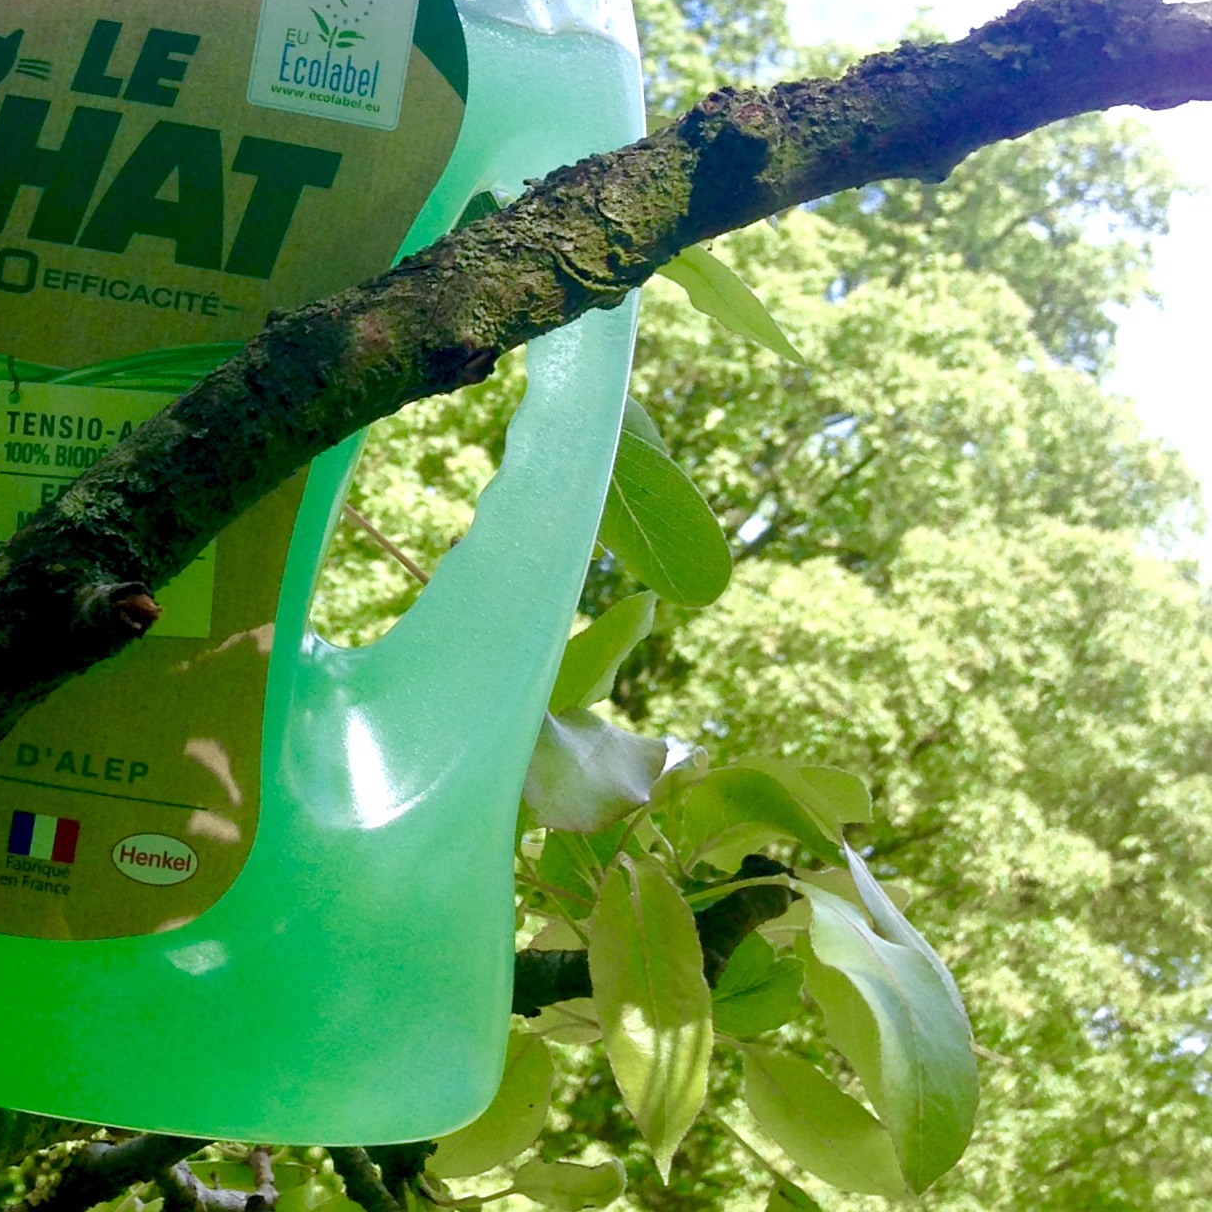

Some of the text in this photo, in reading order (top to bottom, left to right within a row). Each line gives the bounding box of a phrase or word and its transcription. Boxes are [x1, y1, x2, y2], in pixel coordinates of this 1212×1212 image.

[286, 28, 310, 45] EU
[69, 19, 202, 108] LE
[279, 43, 380, 99] Ecolabel
[271, 85, 381, 112] www.ecolabel.eu
[6, 410, 148, 441] TENSIO-A
[3, 441, 50, 466] 100%
[15, 743, 149, 784] D'ALEP
[5, 856, 71, 880] Fabriqué
[118, 843, 192, 873] Henkel
[0, 874, 71, 896] en France
